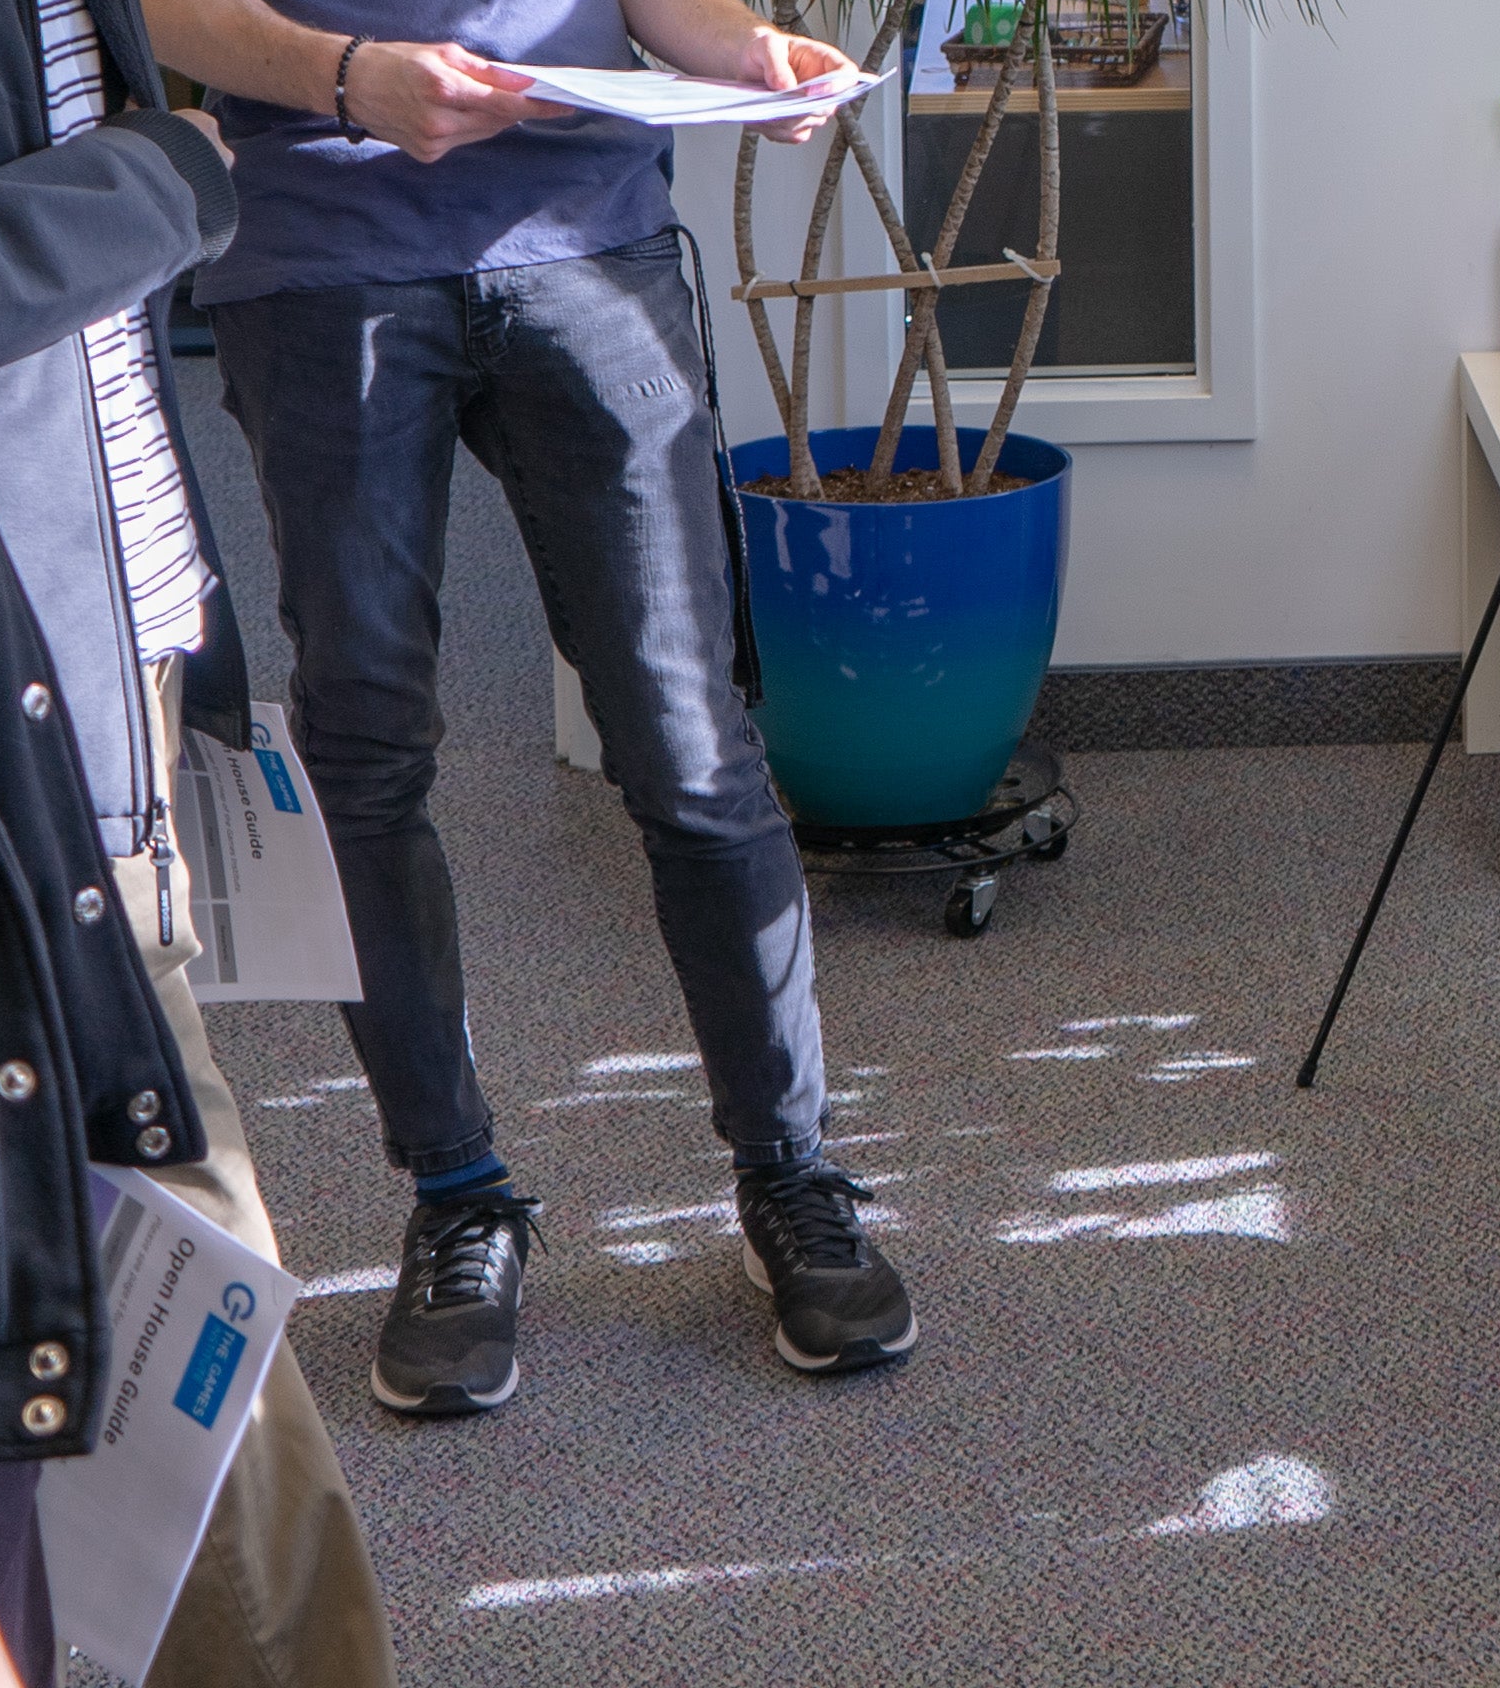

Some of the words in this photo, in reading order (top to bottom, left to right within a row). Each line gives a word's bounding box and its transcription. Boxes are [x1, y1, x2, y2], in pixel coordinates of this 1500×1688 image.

[227, 756, 251, 806] House
[244, 810, 263, 860] Guide
[157, 1237, 196, 1301] Open
[128, 1300, 170, 1376] House
[104, 1379, 139, 1446] Guide
[192, 1363, 223, 1417] GAMES
